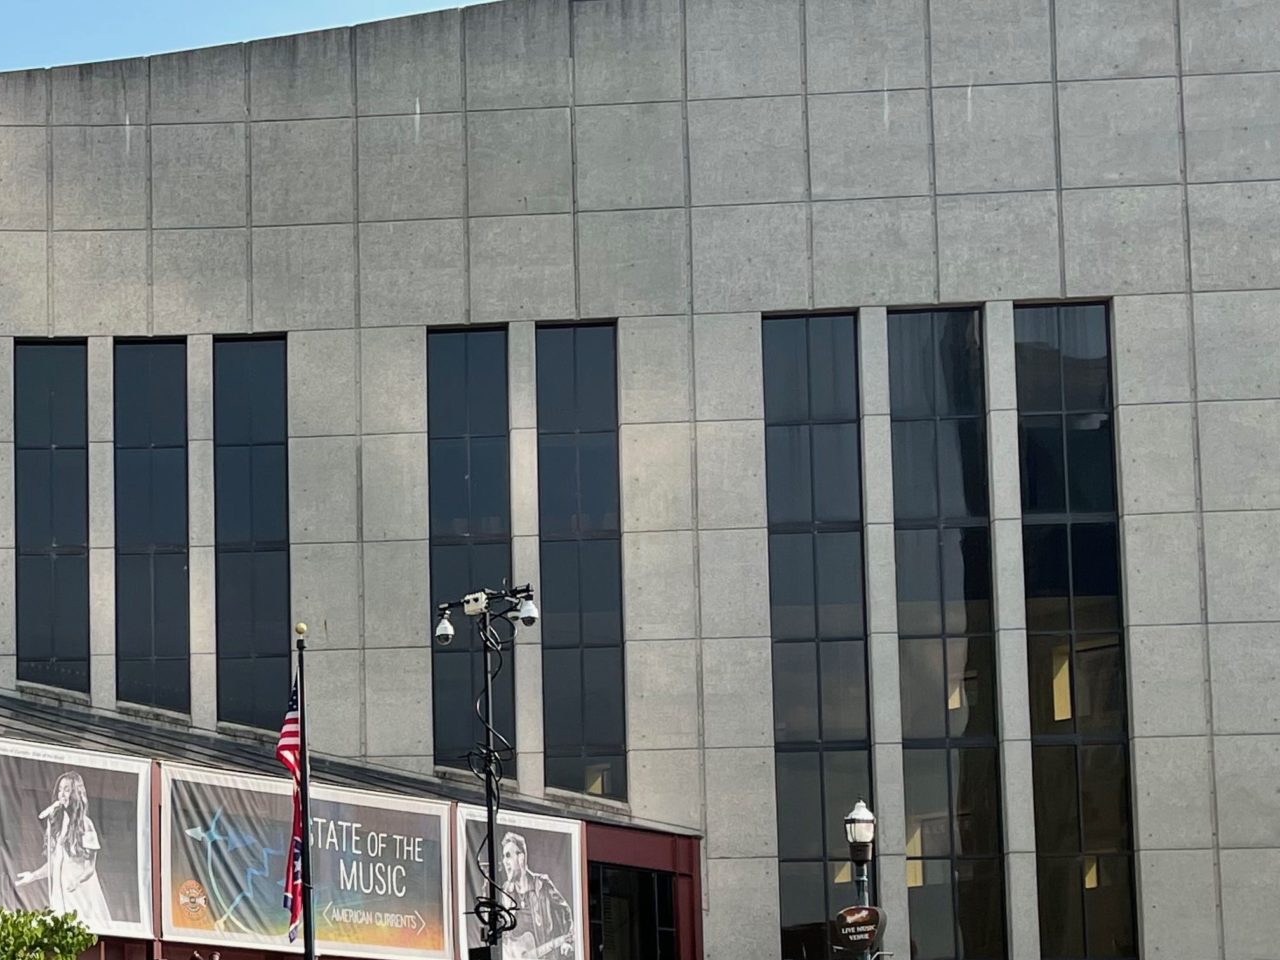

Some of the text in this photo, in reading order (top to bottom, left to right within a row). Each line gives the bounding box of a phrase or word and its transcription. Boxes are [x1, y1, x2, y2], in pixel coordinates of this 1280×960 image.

[367, 831, 388, 857] OF
[392, 834, 424, 862] THE
[339, 858, 406, 897] MUSIC
[330, 907, 417, 929] AMERICAN CURRENTS
[841, 926, 856, 934] LIVE
